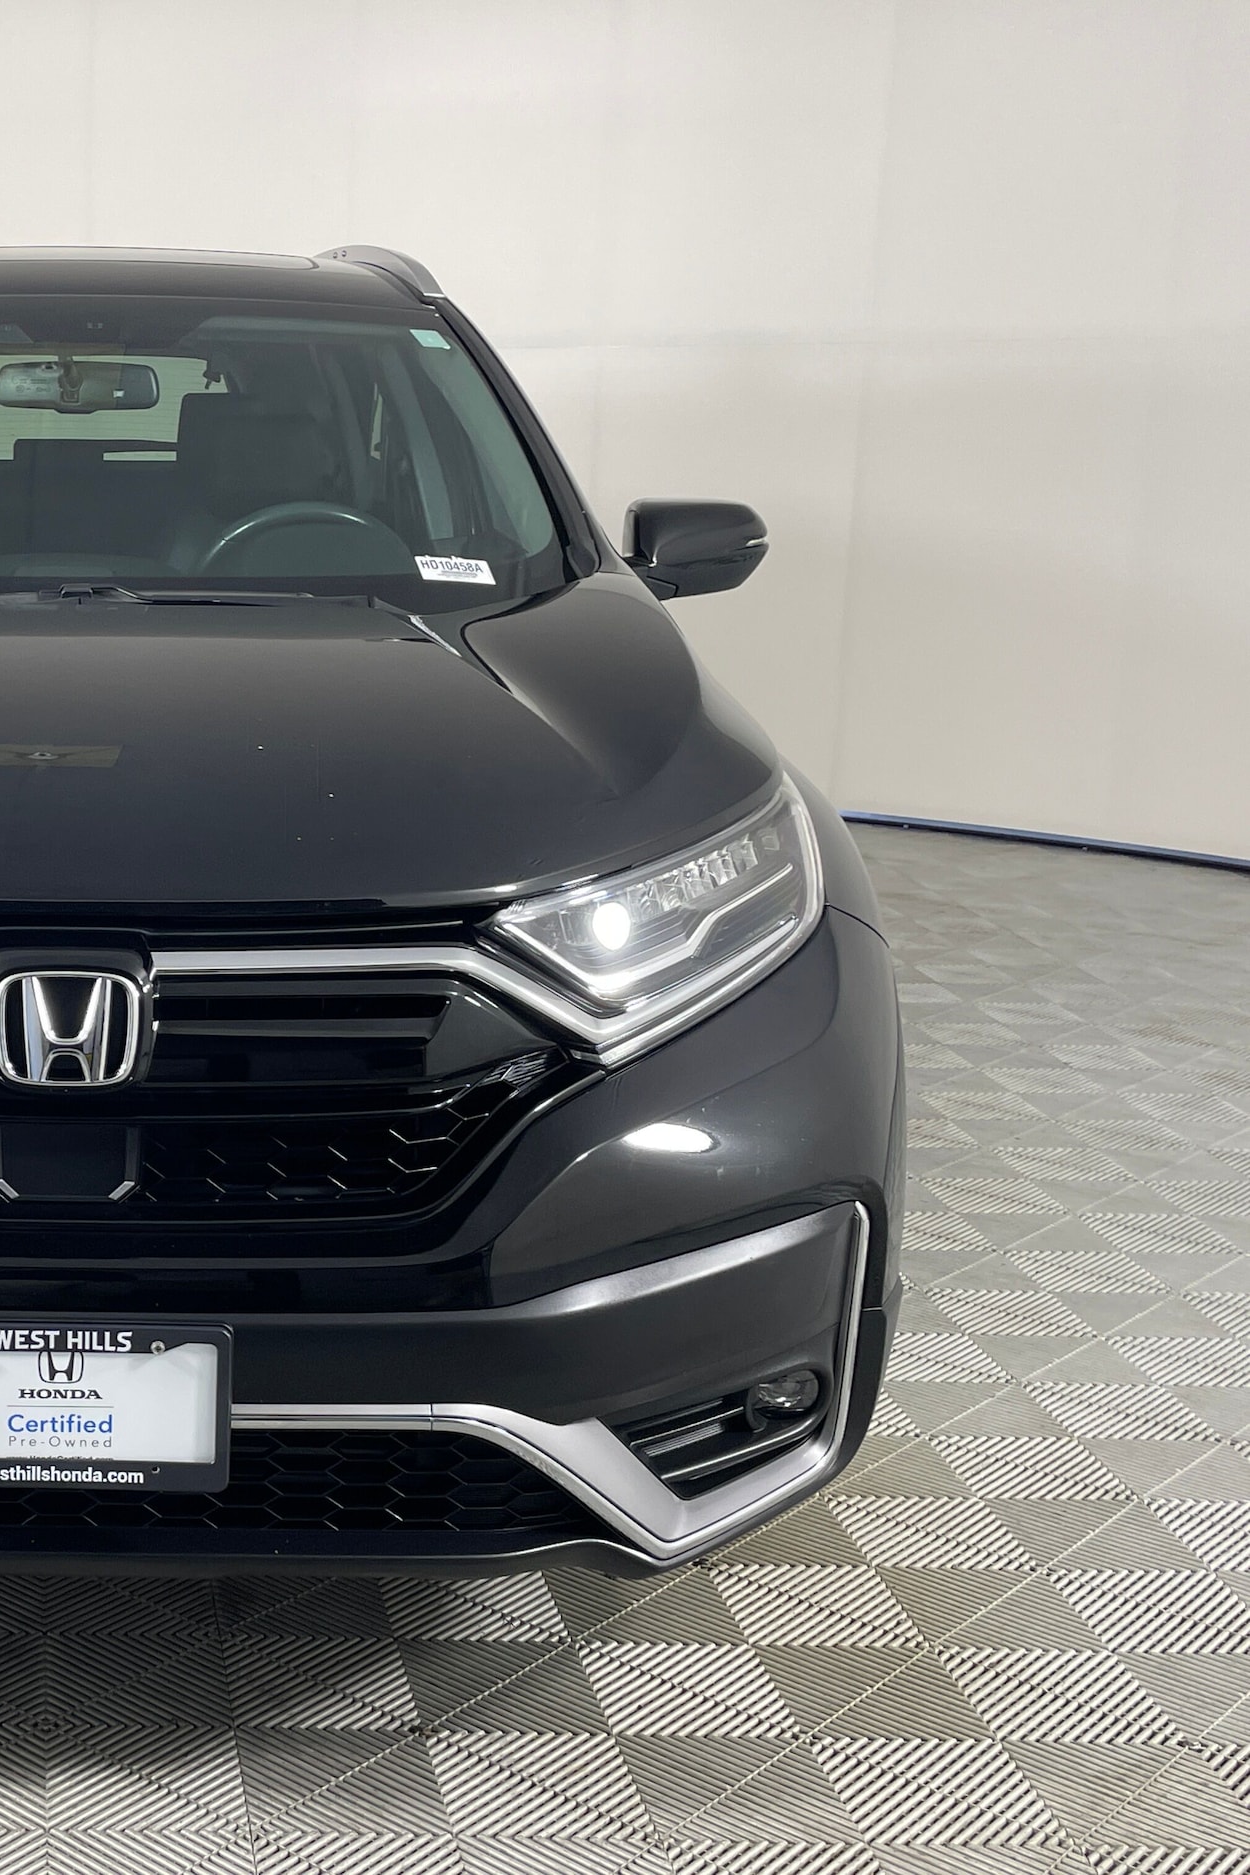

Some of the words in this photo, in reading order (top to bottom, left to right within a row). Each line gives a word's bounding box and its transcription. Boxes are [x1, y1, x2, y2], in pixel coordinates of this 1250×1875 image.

[67, 1330, 134, 1353] HILLS
[18, 1388, 103, 1401] HONDA
[7, 1413, 113, 1434] Certified
[8, 1435, 113, 1448] Pre-Owned
